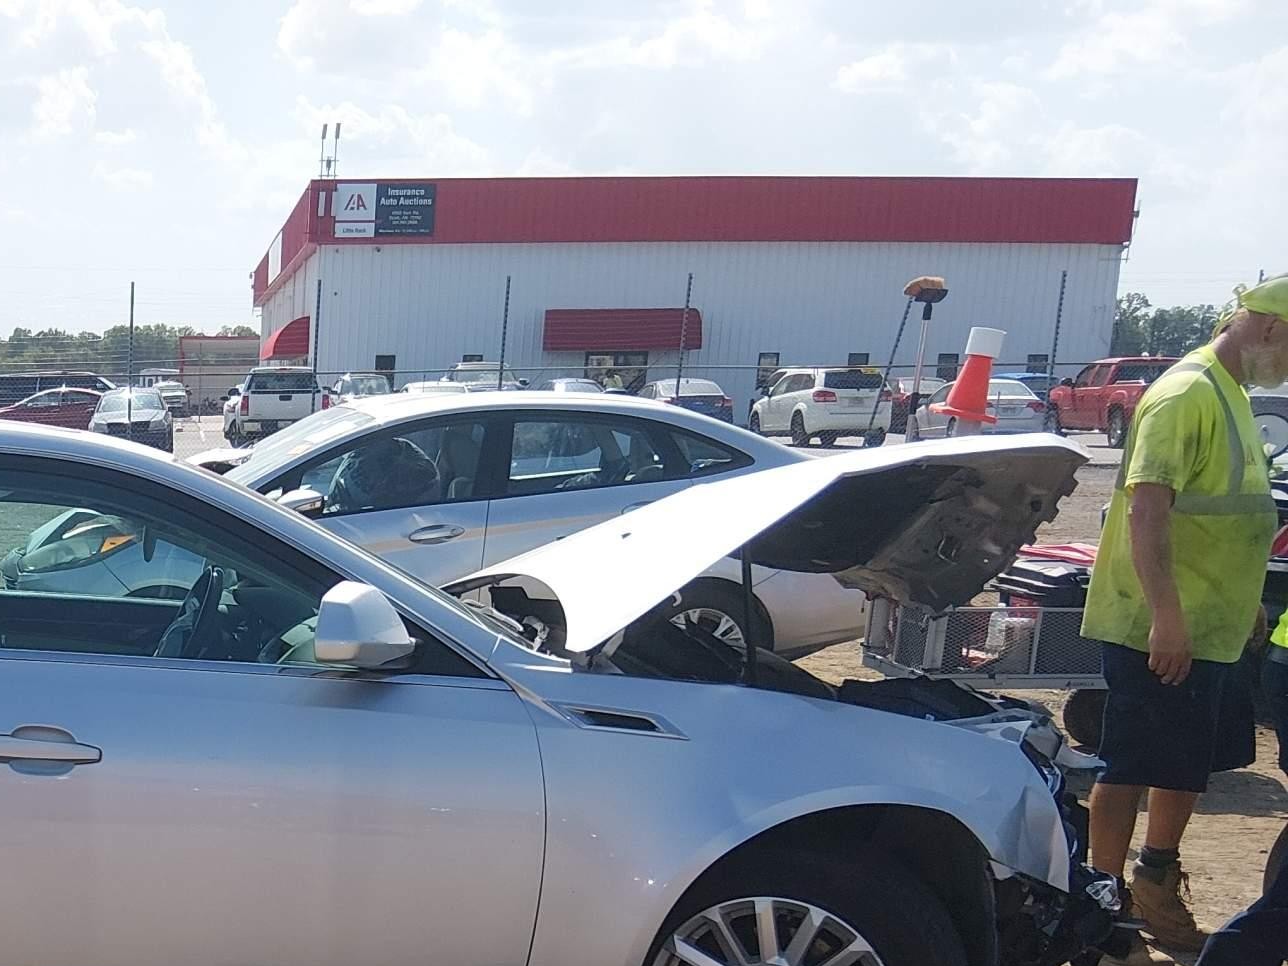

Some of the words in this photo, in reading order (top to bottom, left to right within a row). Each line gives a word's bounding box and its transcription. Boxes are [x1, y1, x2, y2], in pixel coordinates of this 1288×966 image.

[388, 187, 425, 196] Insurance
[380, 197, 398, 206] Auto
[399, 196, 432, 206] Auctions
